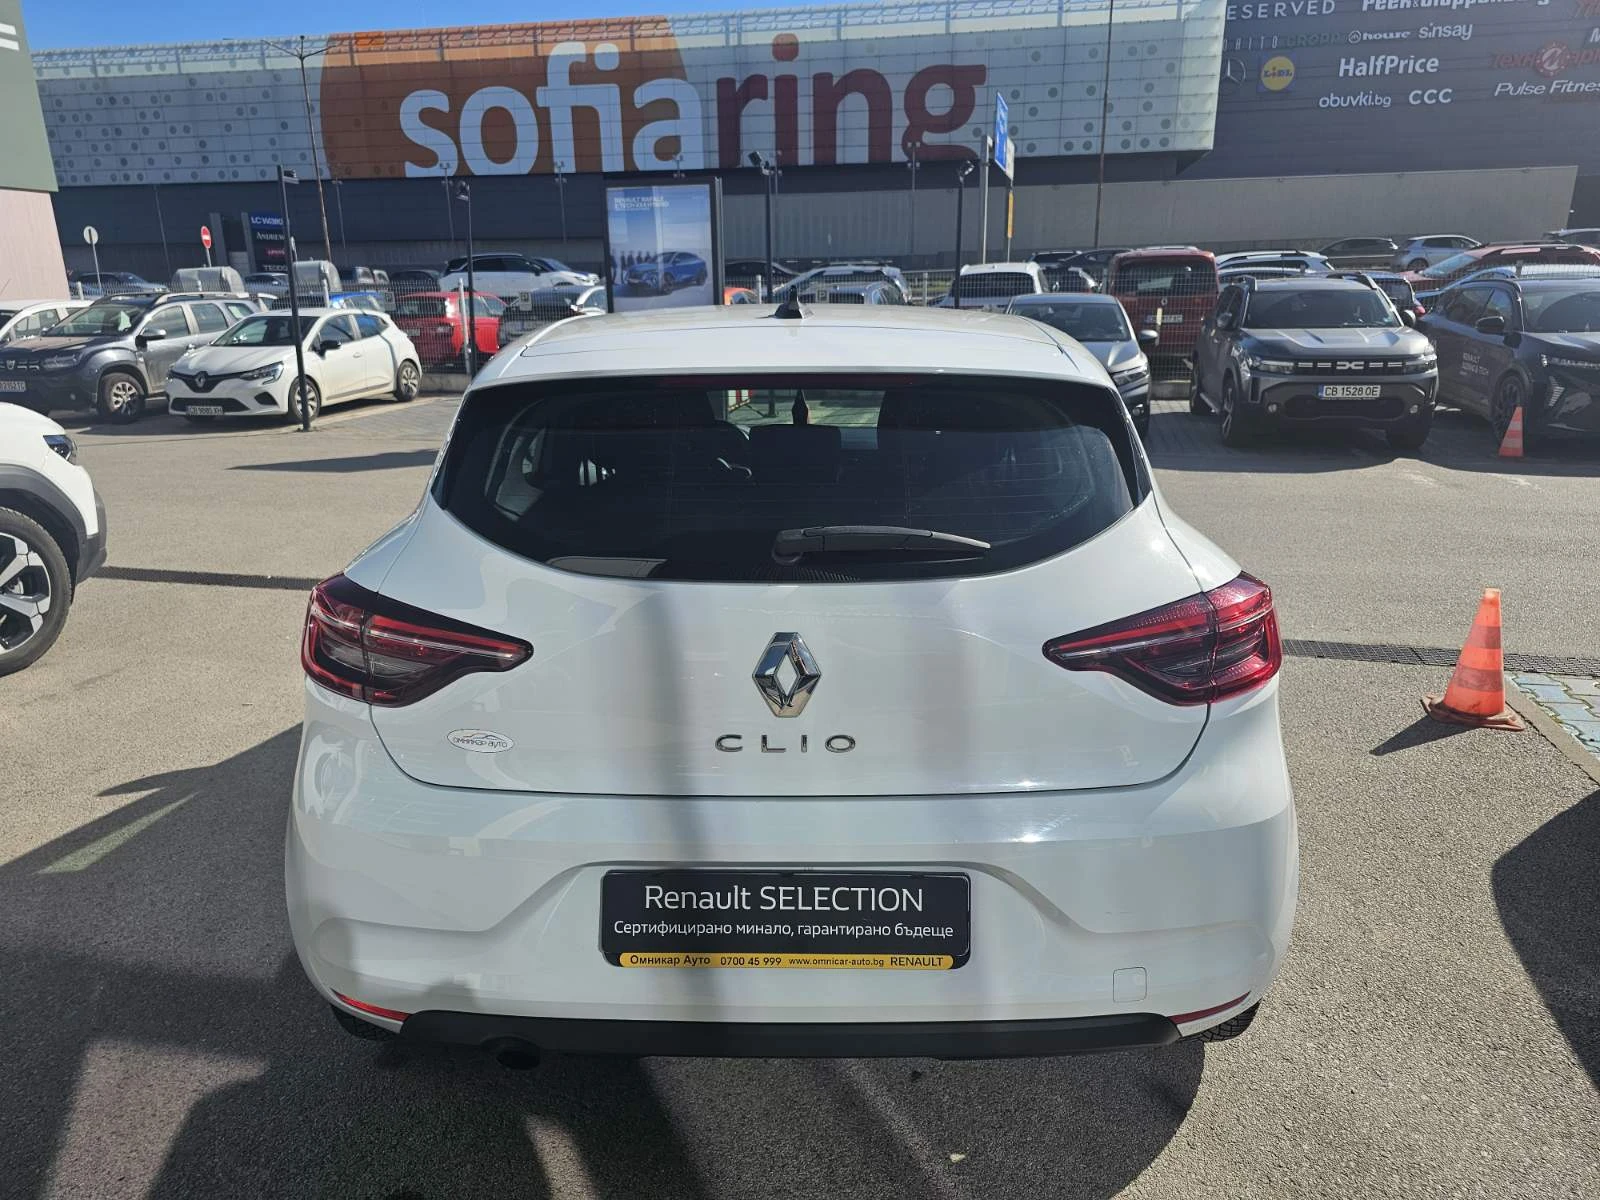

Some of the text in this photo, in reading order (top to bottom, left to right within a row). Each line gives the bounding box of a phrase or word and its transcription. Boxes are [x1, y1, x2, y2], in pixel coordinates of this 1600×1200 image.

[1226, 0, 1335, 20] ESERVED
[1418, 22, 1474, 41] sinsay
[1338, 55, 1440, 78] HalfPrice
[1408, 88, 1453, 105] CCC
[1494, 81, 1546, 97] Pulse
[1318, 91, 1392, 109] obuvki.bg
[1341, 386, 1364, 397] 1528
[715, 734, 856, 753] CLIO
[644, 885, 923, 912] Renault SELECTION
[613, 920, 954, 939] Сертифицирано минало, гарантирано бъдеще
[629, 954, 944, 968] Омникар Ауто 0700 45 999 www.omnicar-auto.bg RENAULT
